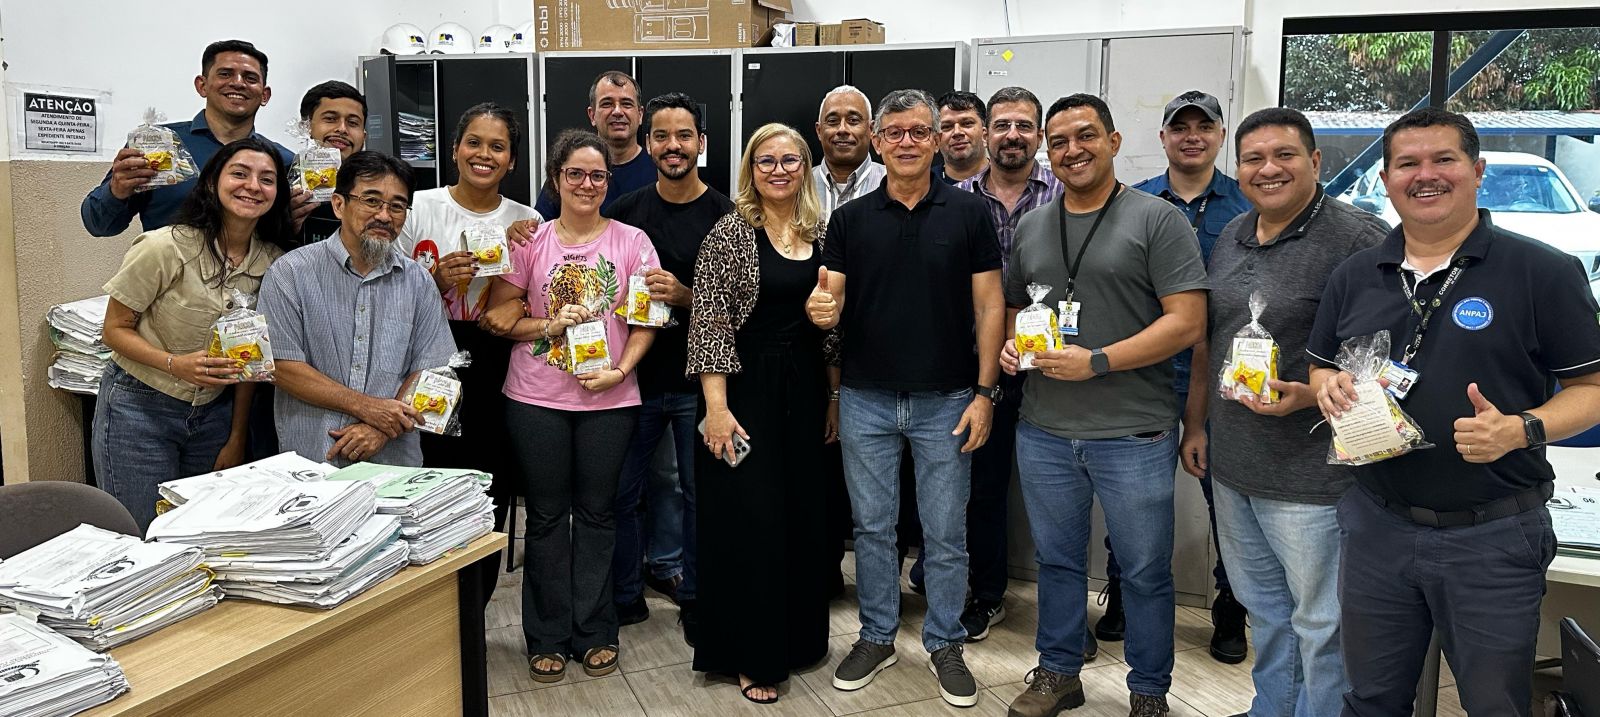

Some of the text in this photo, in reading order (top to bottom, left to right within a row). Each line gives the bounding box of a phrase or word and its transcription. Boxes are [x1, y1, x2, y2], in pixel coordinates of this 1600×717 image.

[539, 6, 548, 34] ibbl
[29, 98, 92, 114] ATENÇÃO
[1439, 267, 1460, 295] CORRETOR
[1459, 310, 1486, 318] ANPAJ
